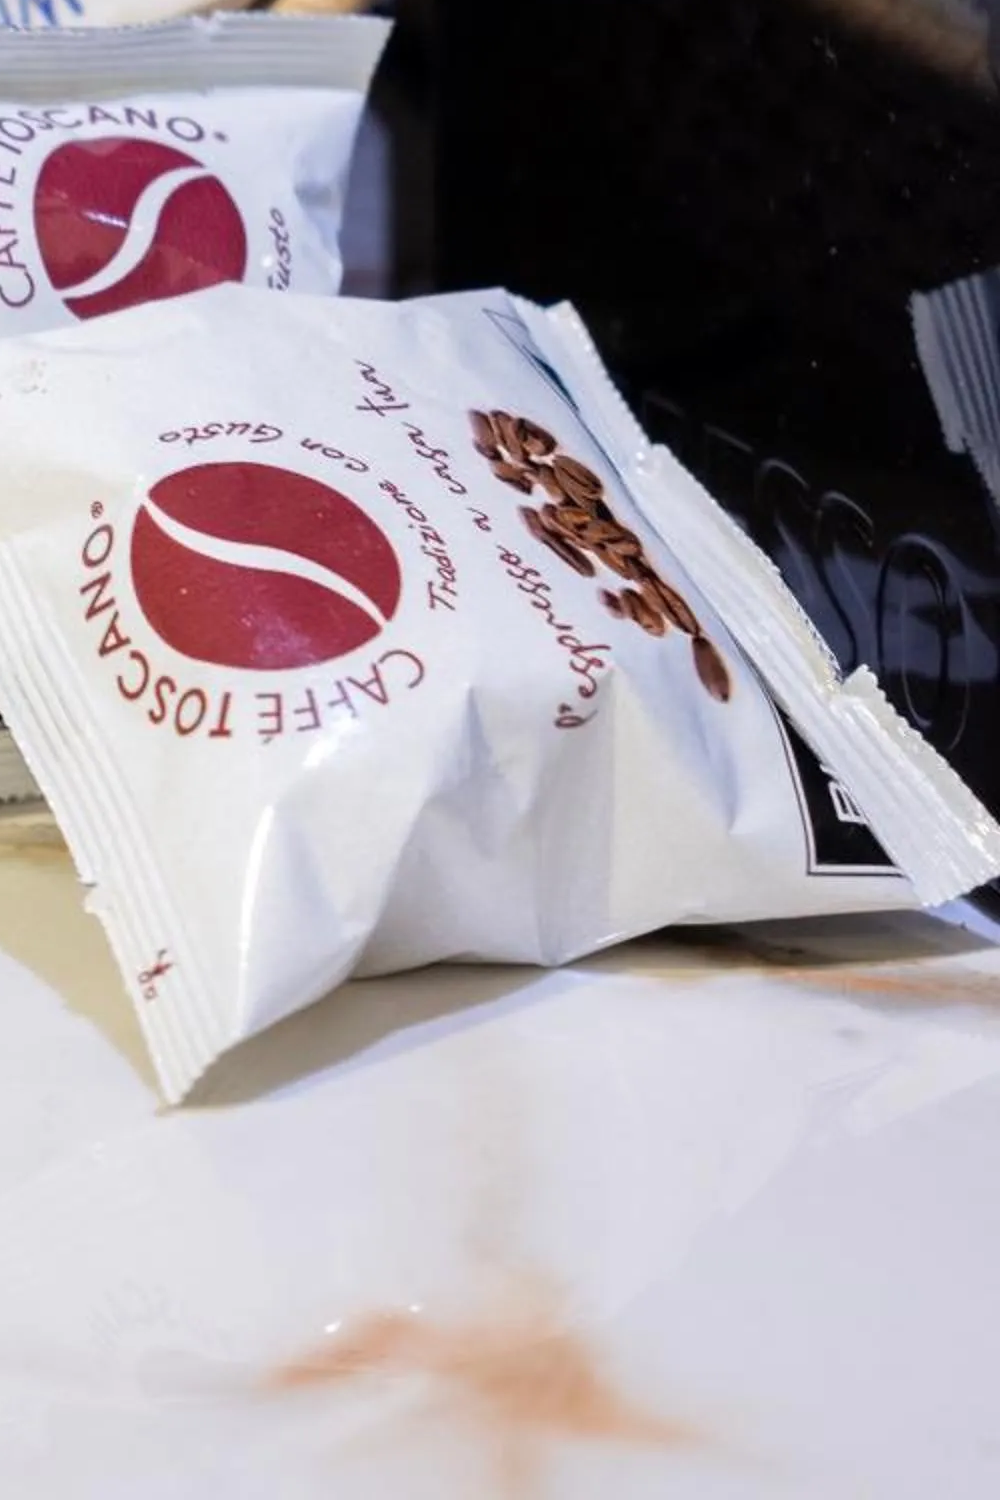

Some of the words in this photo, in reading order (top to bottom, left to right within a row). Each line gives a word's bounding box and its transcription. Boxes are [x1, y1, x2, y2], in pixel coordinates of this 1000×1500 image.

[353, 358, 410, 417] tua
[158, 419, 283, 447] Gusto
[300, 437, 370, 473] con
[401, 421, 467, 495] casa
[378, 478, 458, 611] Tradizione
[466, 507, 491, 532] a
[255, 648, 425, 746] CAFFÉ
